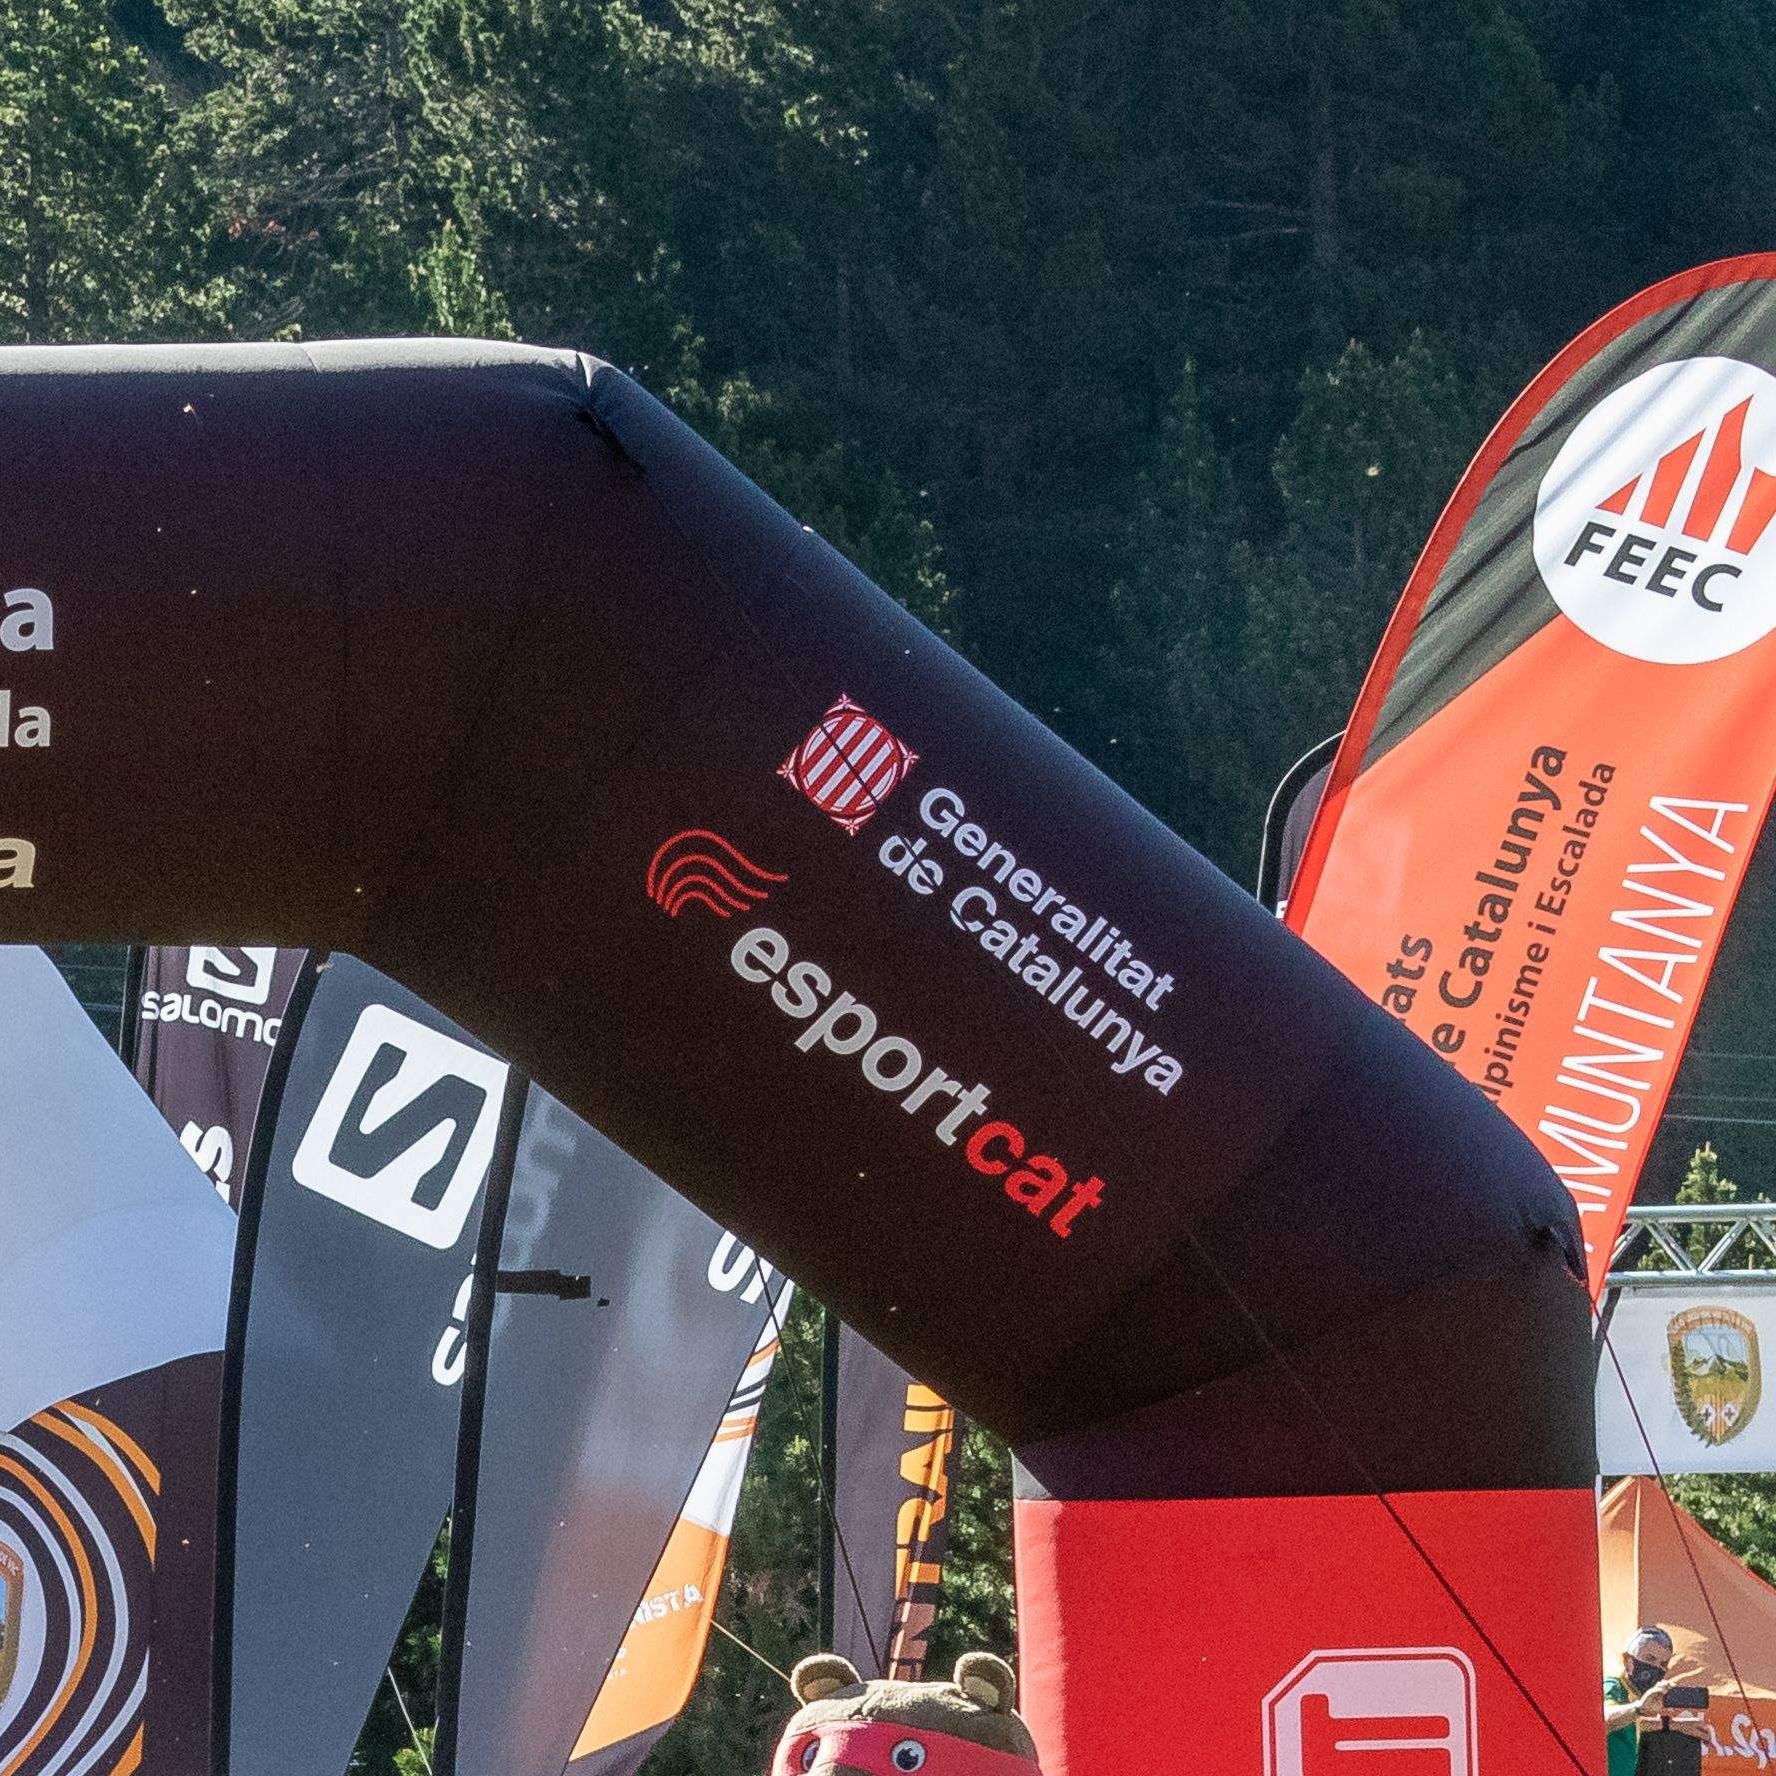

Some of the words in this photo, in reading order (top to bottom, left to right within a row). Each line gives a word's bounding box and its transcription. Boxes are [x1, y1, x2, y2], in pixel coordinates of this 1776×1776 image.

[1564, 521, 1744, 613] FEEC
[877, 834, 944, 896] de
[949, 885, 1186, 1096] Catalunya
[919, 786, 1177, 1011] Generalitat
[1438, 743, 1568, 1010] Catalunya
[1481, 940, 1550, 1101] lpinisme
[1536, 761, 1618, 915] Escalada
